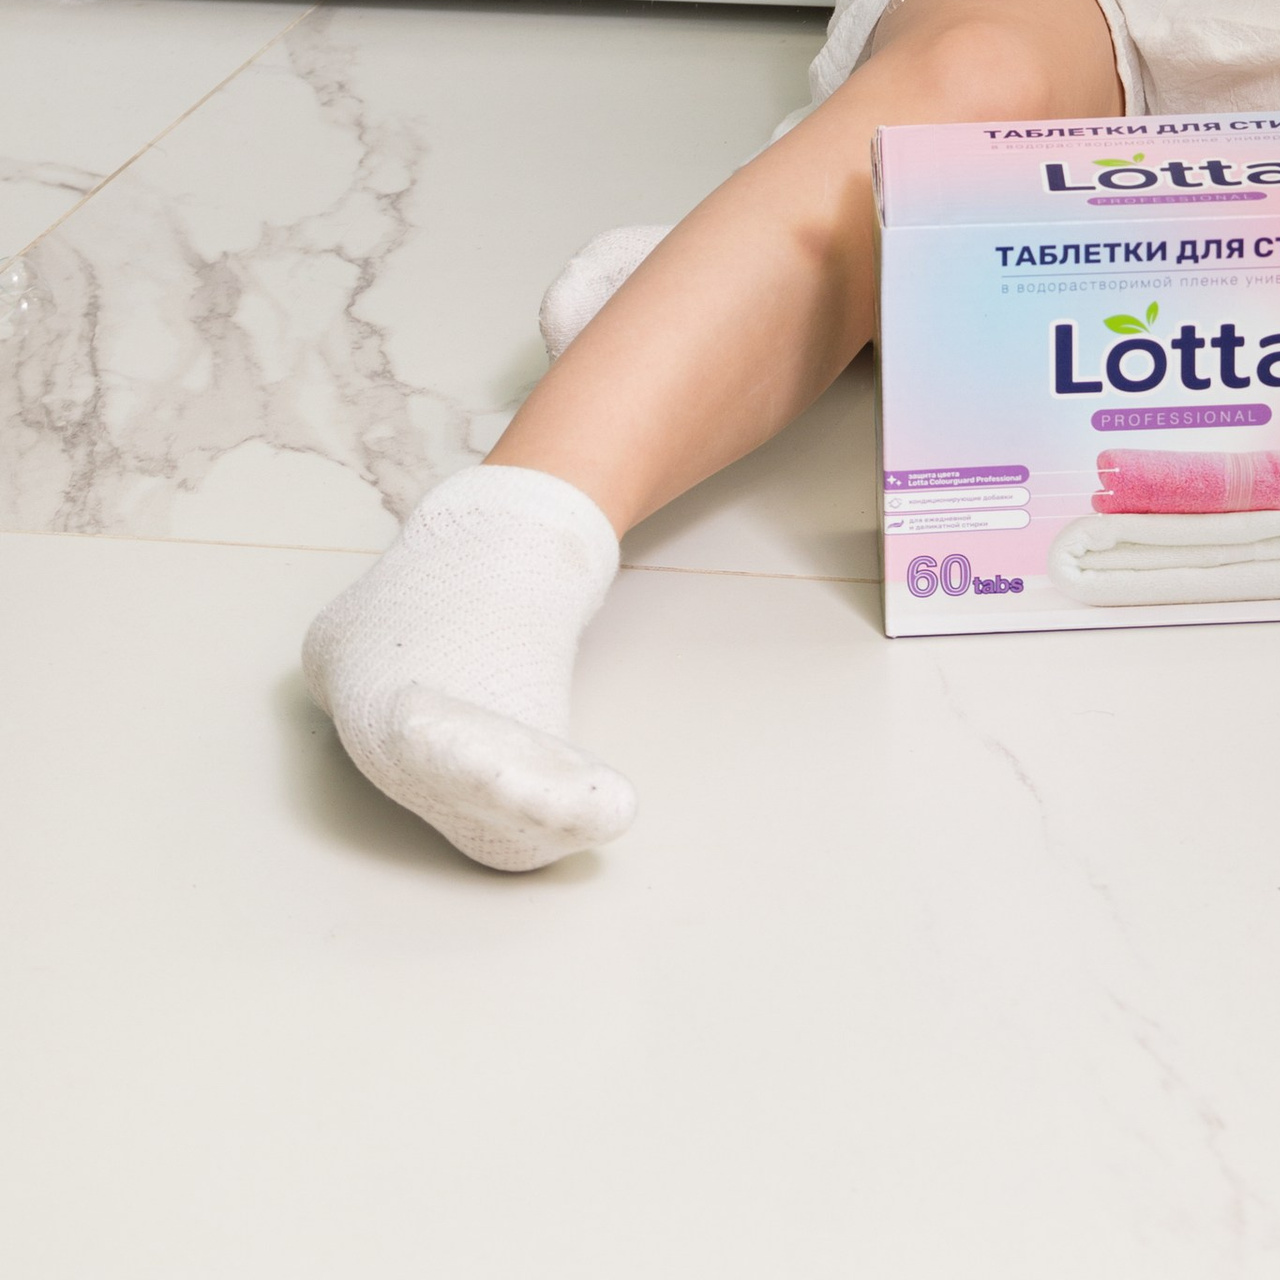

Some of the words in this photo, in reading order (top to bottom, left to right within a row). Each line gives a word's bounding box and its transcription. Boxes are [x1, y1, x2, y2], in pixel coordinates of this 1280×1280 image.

[983, 124, 1148, 140] ТАБЛЕТКИ
[1156, 121, 1222, 135] ДЛЯ
[1097, 194, 1249, 206] PROFESSIONAL
[995, 241, 1168, 267] ТАБЛЕТКИ
[1176, 238, 1245, 264] ДЛЯ
[1001, 284, 1009, 294] в
[1016, 276, 1173, 294] водорастворимой
[1180, 274, 1239, 287] пленке
[1101, 410, 1257, 428] PROFESSIONAL
